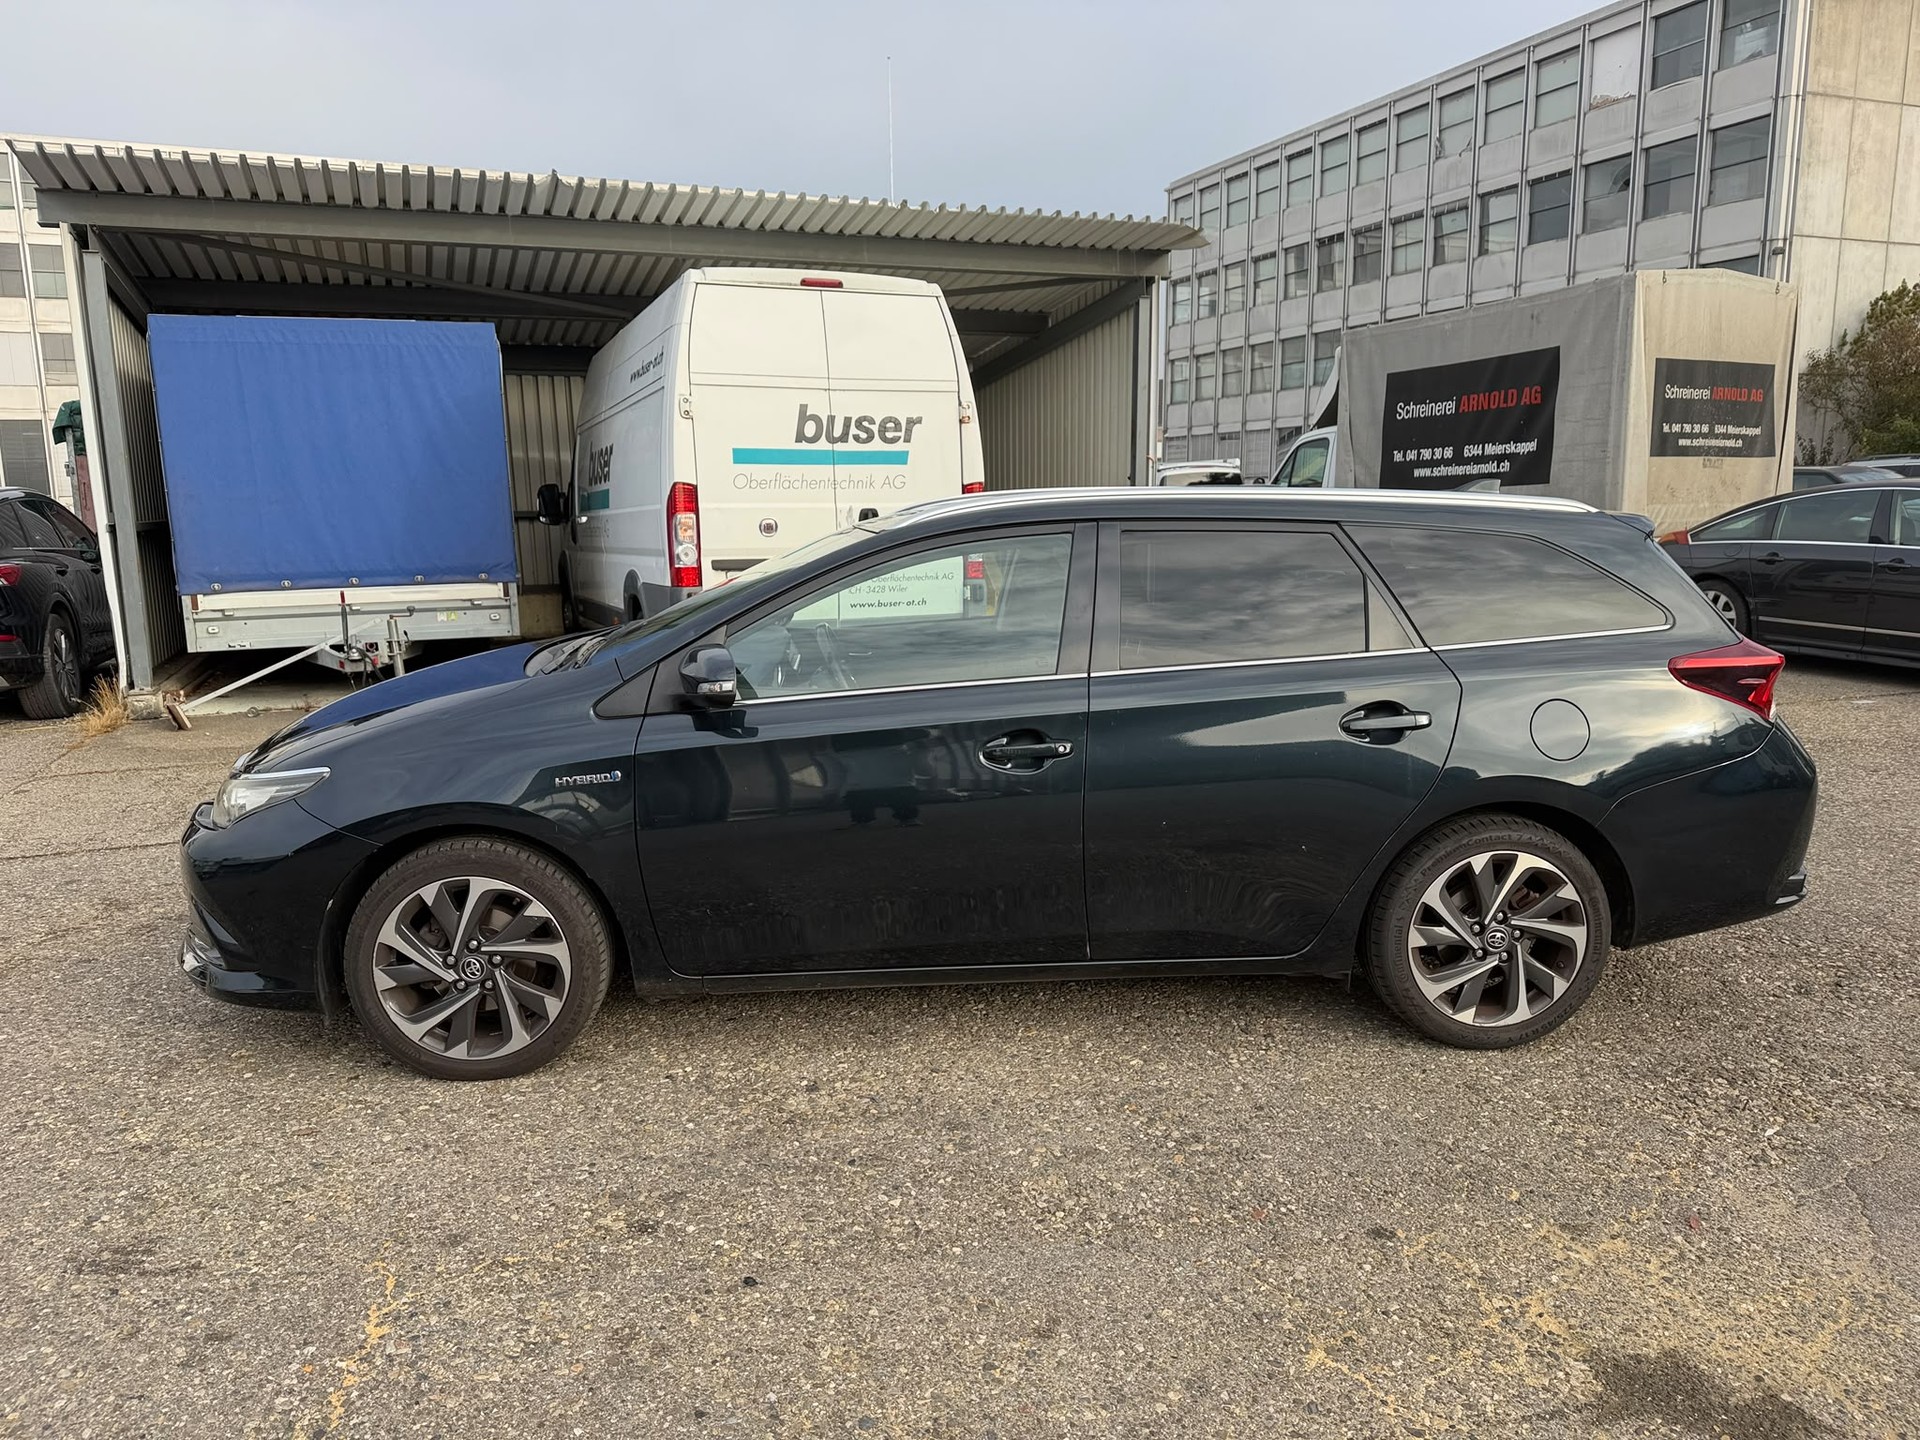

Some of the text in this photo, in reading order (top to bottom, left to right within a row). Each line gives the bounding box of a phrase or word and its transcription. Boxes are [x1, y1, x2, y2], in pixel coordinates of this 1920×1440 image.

[1665, 384, 1763, 402] Schreinerei ARNOLD AG
[1396, 385, 1542, 420] Schreinerei ARNOLD AG
[794, 403, 923, 444] buser
[1672, 423, 1681, 433] 041
[1692, 424, 1701, 433] 30
[1727, 425, 1762, 437] Meierskappel
[1393, 438, 1538, 462] Tel. 041 790 30 66 6344 Meierskappel
[588, 441, 614, 487] buser
[1413, 459, 1510, 478] www.schreinereiarnold.ch
[733, 472, 907, 491] Oberflächentechnik AG
[941, 572, 955, 581] AG
[888, 584, 908, 593] Wiler
[850, 598, 927, 609] www.buser-ot.ch
[554, 773, 611, 788] HYBRID
